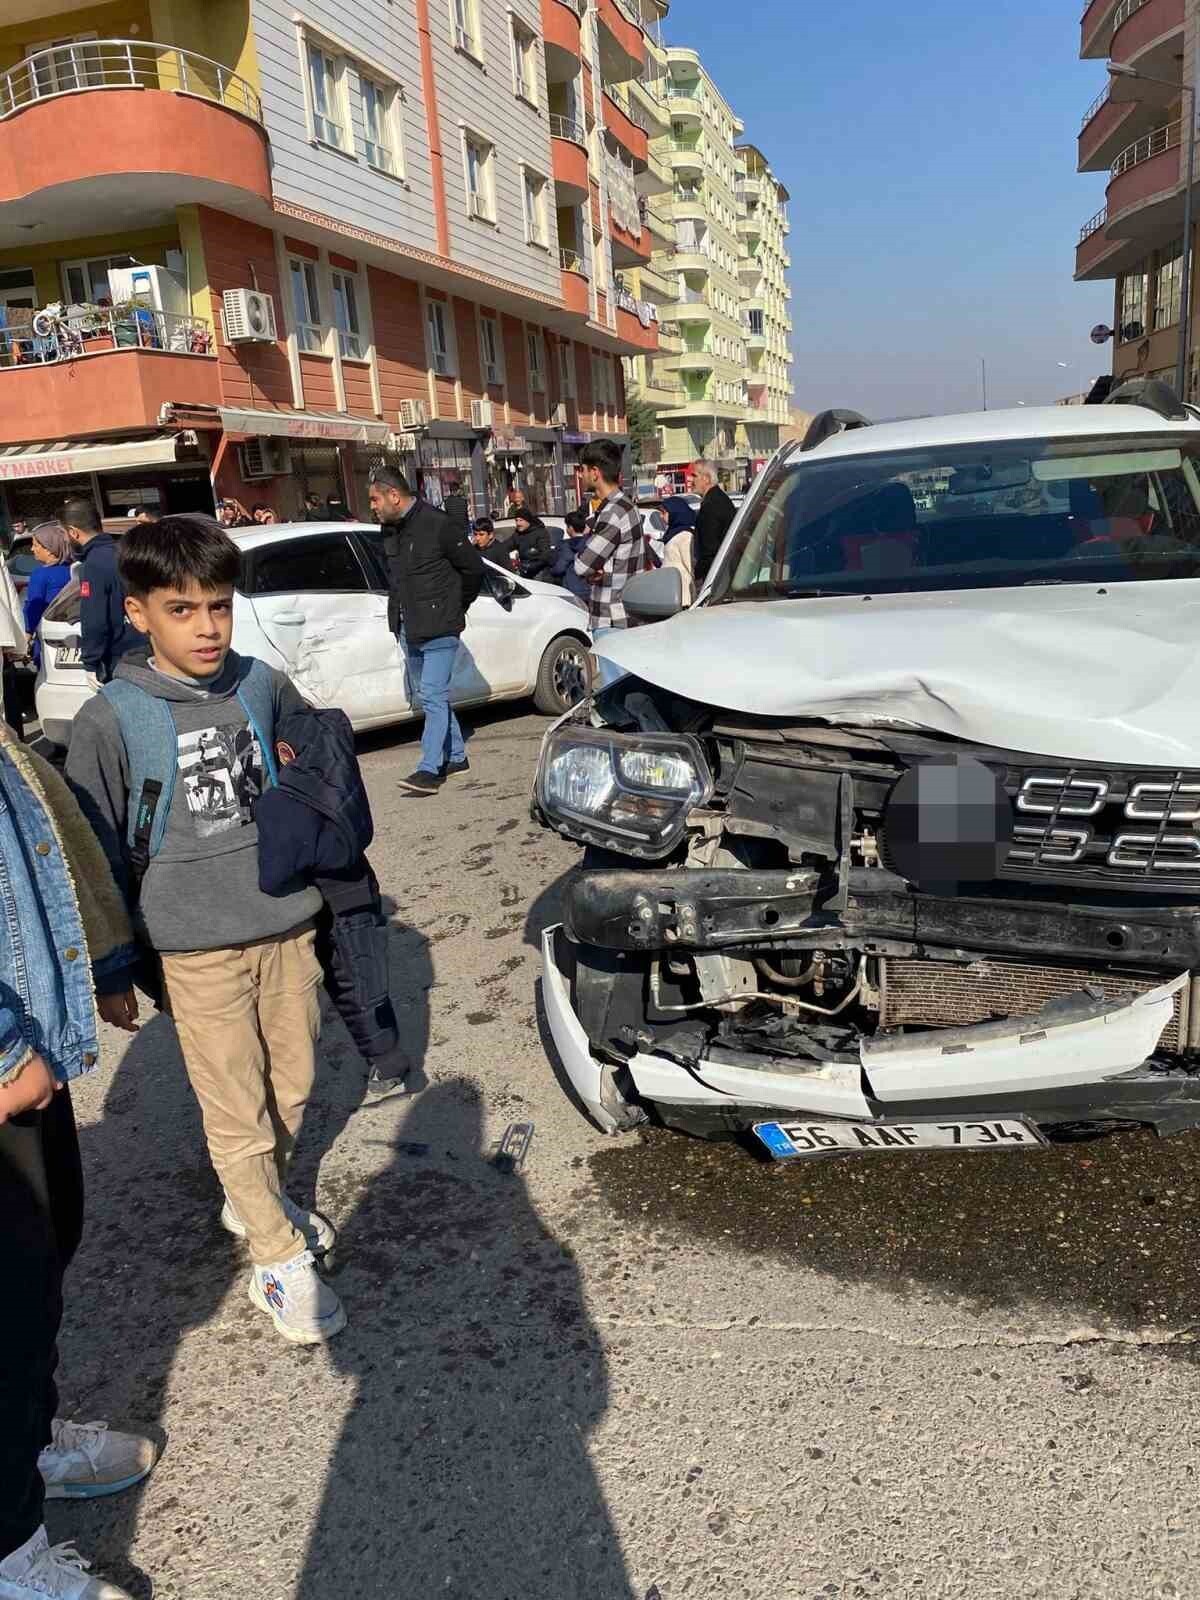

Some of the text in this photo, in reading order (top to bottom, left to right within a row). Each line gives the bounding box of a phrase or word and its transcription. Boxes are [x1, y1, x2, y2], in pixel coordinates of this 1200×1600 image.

[13, 457, 73, 476] MARKET
[784, 1127, 839, 1149] 56
[852, 1127, 919, 1146] AAF
[937, 1123, 1023, 1144] 734
